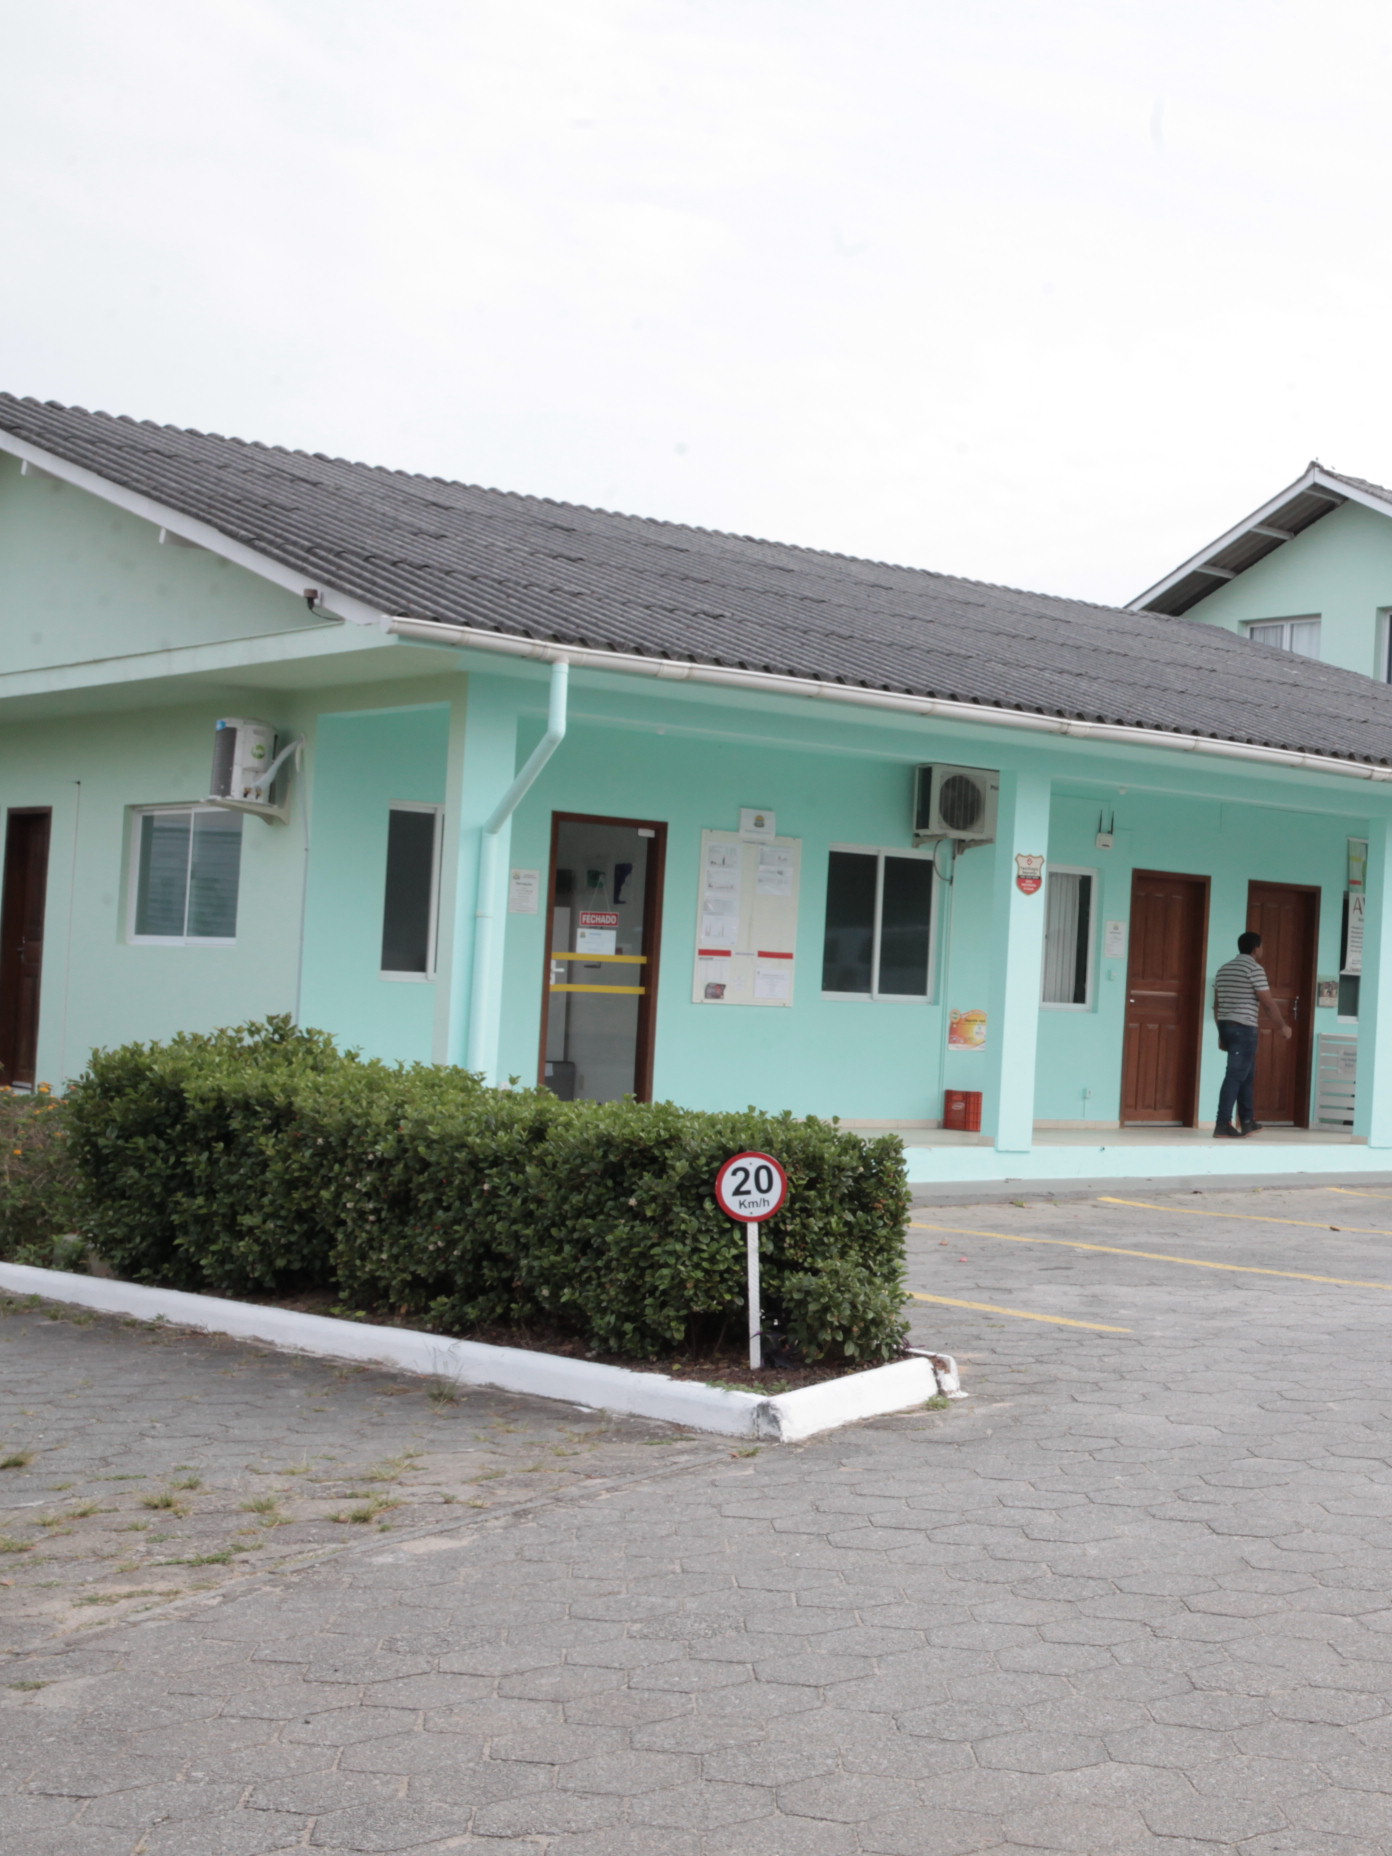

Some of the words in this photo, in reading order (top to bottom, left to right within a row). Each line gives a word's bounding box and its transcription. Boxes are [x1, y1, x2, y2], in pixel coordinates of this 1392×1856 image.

[582, 914, 617, 925] FECHADO
[731, 1164, 774, 1197] 20
[738, 1198, 770, 1209] Km/h
